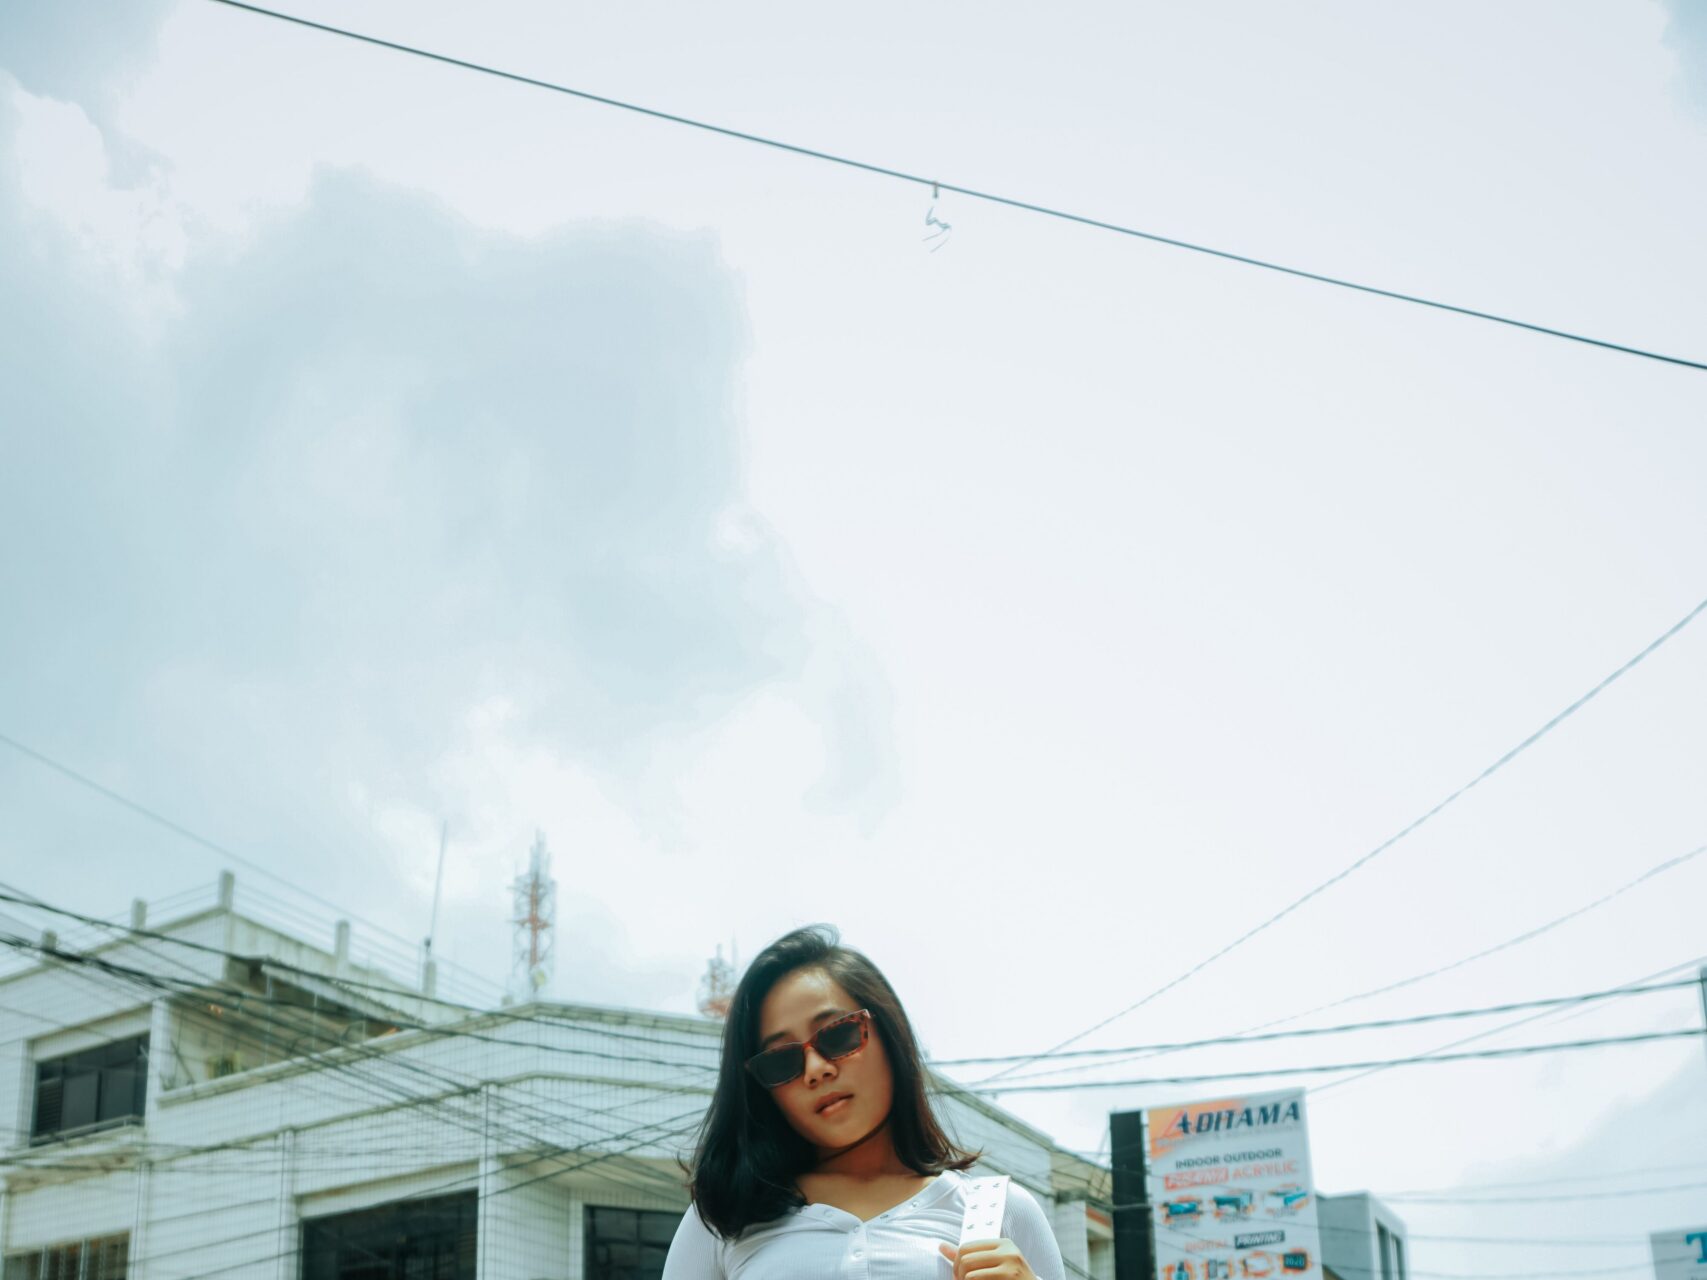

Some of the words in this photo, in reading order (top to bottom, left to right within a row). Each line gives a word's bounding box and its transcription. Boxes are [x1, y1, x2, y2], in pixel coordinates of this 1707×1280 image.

[1162, 1101, 1301, 1138] ADITAMA
[1175, 1155, 1220, 1169] INDOOR
[1223, 1148, 1283, 1164] OUTDOOR
[1232, 1161, 1298, 1180] ACRYLIC
[1236, 1231, 1282, 1247] PRINTING
